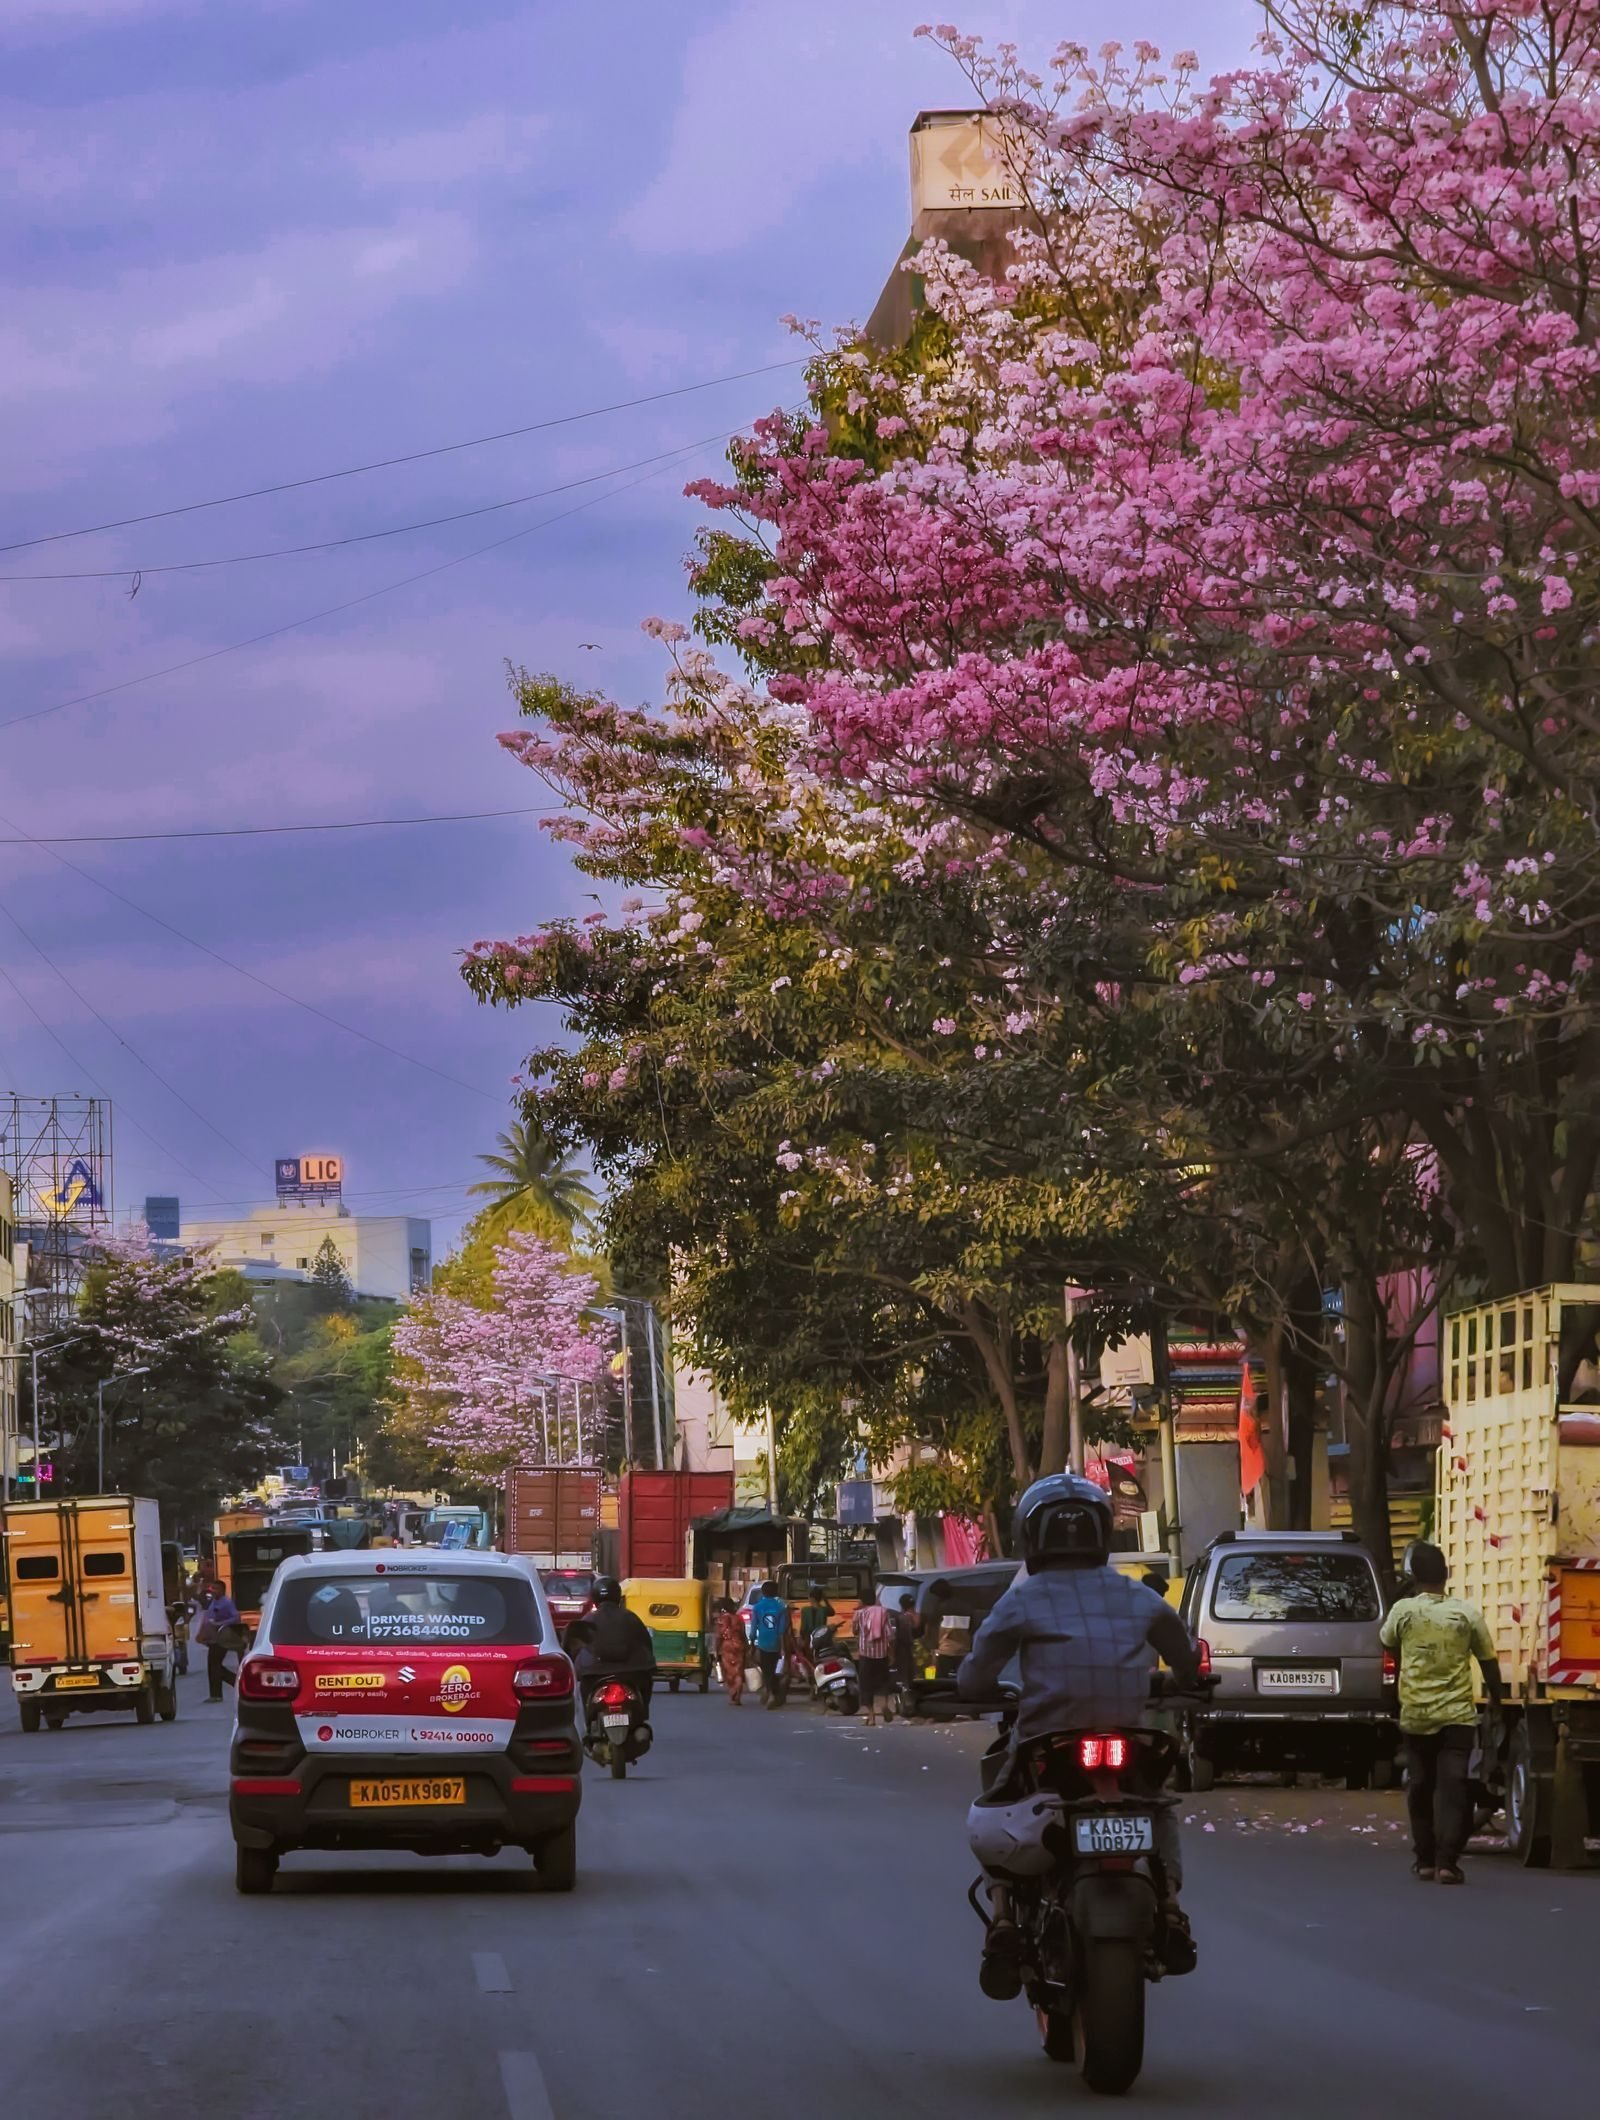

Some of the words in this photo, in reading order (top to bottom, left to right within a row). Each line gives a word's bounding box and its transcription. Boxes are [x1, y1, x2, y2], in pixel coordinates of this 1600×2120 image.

[948, 183, 976, 202] सेल
[981, 187, 1013, 201] SAIL
[305, 1160, 337, 1180] LIC
[371, 1615, 425, 1625] DRIVERS
[428, 1615, 486, 1625] WANTED
[372, 1626, 470, 1637] 9736844000
[318, 1677, 354, 1687] RENT
[355, 1676, 381, 1686] OUT
[1269, 1673, 1326, 1684] KA08M9376
[333, 1690, 365, 1698] property
[367, 1690, 388, 1698] easily
[441, 1683, 471, 1694] ZERO
[430, 1691, 481, 1703] BROKERAGE
[336, 1729, 399, 1739] NOBROKER
[420, 1730, 453, 1741] 92414
[456, 1732, 494, 1742] 00000
[1090, 1818, 1144, 1834] KA05L
[1091, 1835, 1144, 1850] U0877
